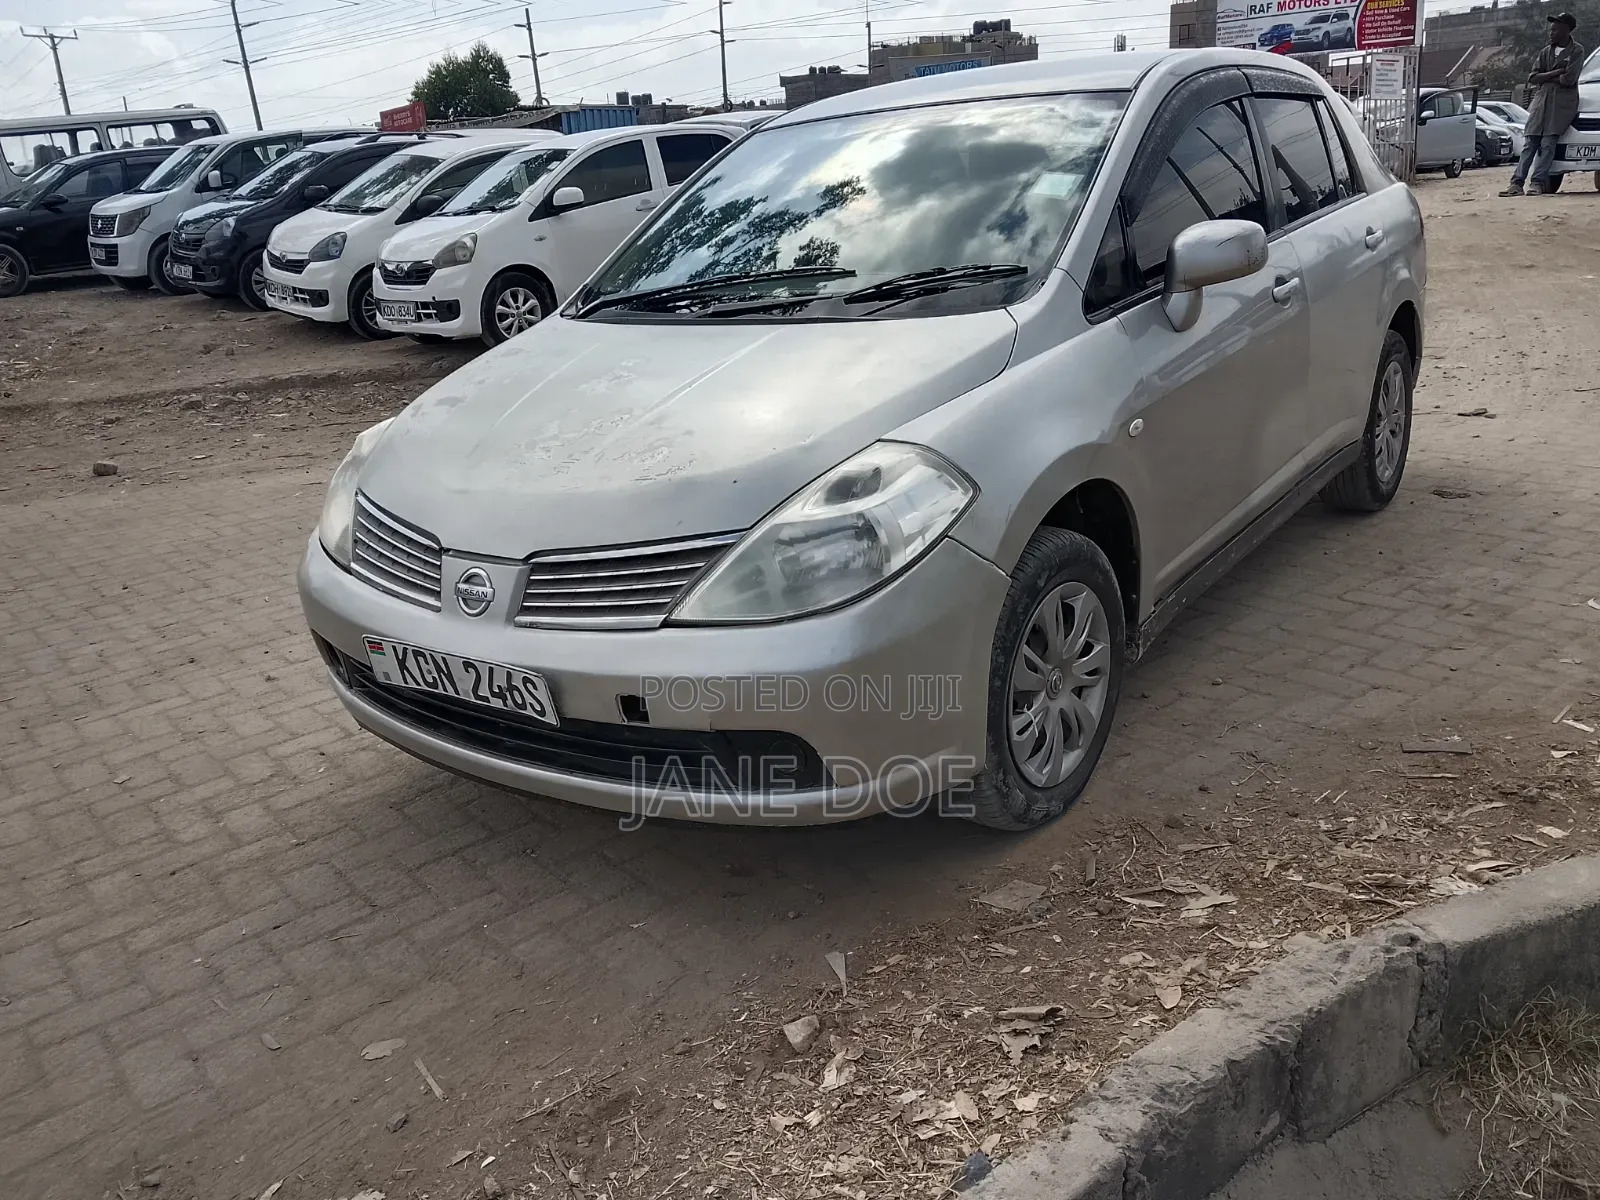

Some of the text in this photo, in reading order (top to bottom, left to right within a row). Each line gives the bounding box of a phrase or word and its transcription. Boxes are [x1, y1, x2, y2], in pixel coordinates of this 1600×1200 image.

[1249, 0, 1330, 15] RAF MOTORS
[1379, 0, 1405, 8] SERVICES
[920, 66, 940, 76] TATU
[942, 60, 979, 73] MOTORS
[1576, 146, 1597, 157] KDM
[457, 586, 488, 599] NISSAN
[391, 644, 547, 718] KCN 246S
